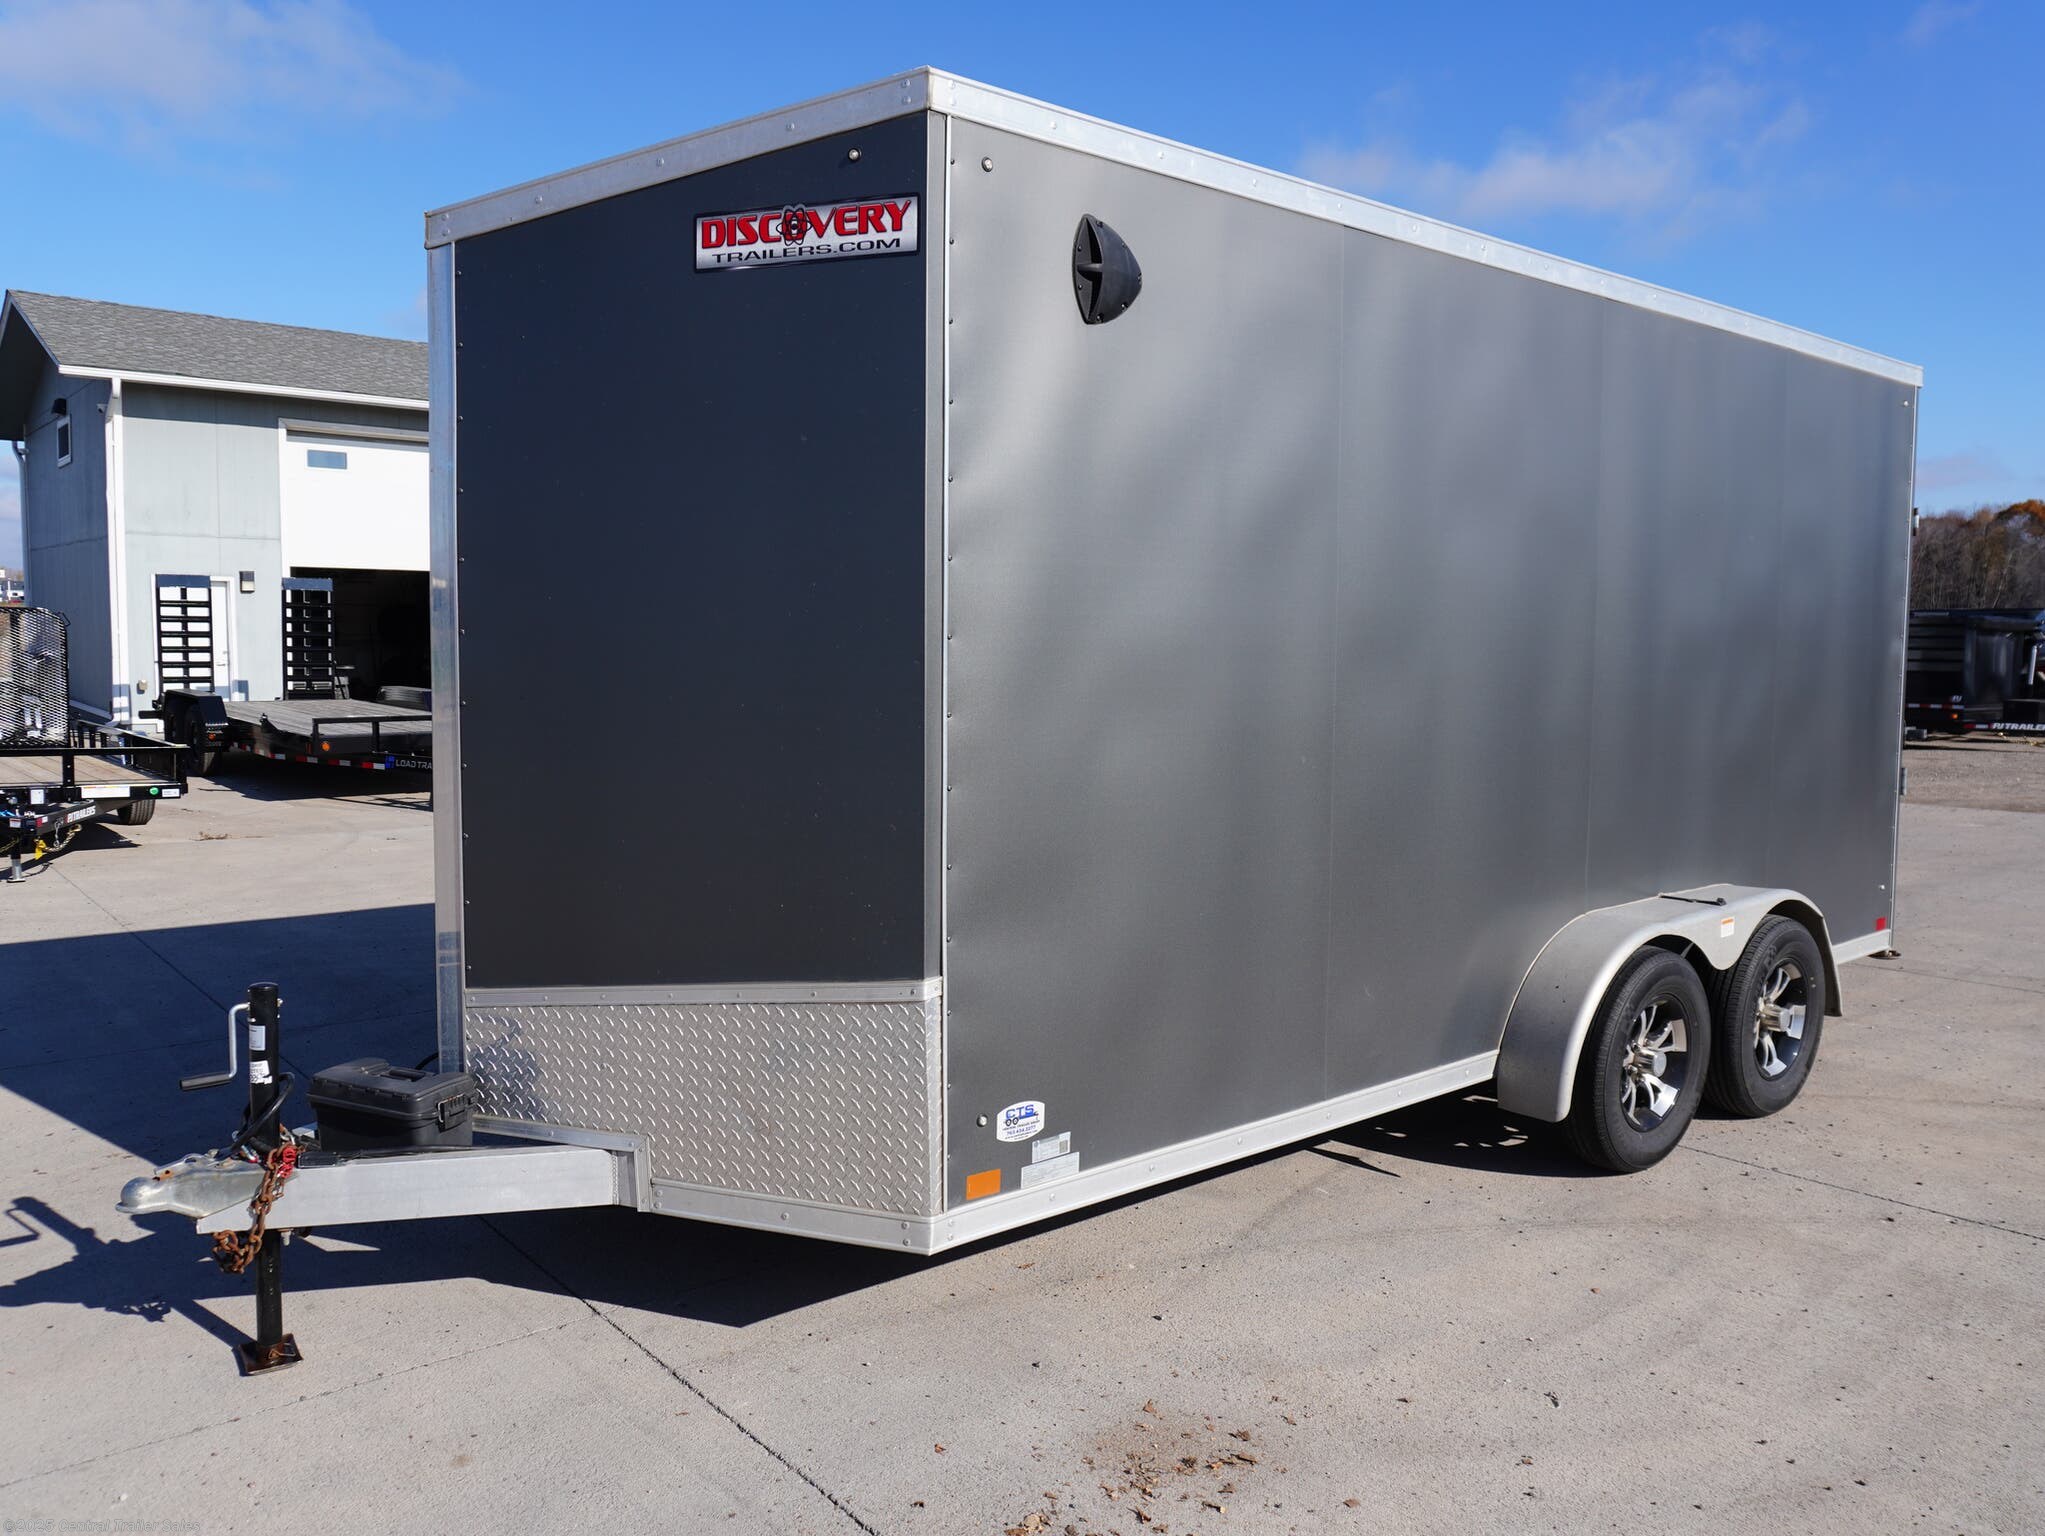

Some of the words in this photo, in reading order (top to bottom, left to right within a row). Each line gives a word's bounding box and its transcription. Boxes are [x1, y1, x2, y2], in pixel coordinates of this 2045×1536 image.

[702, 200, 911, 249] DISCOVERY
[712, 238, 901, 264] TRAILERS.COM
[395, 759, 417, 768] LOAD
[1006, 1104, 1035, 1119] CTS
